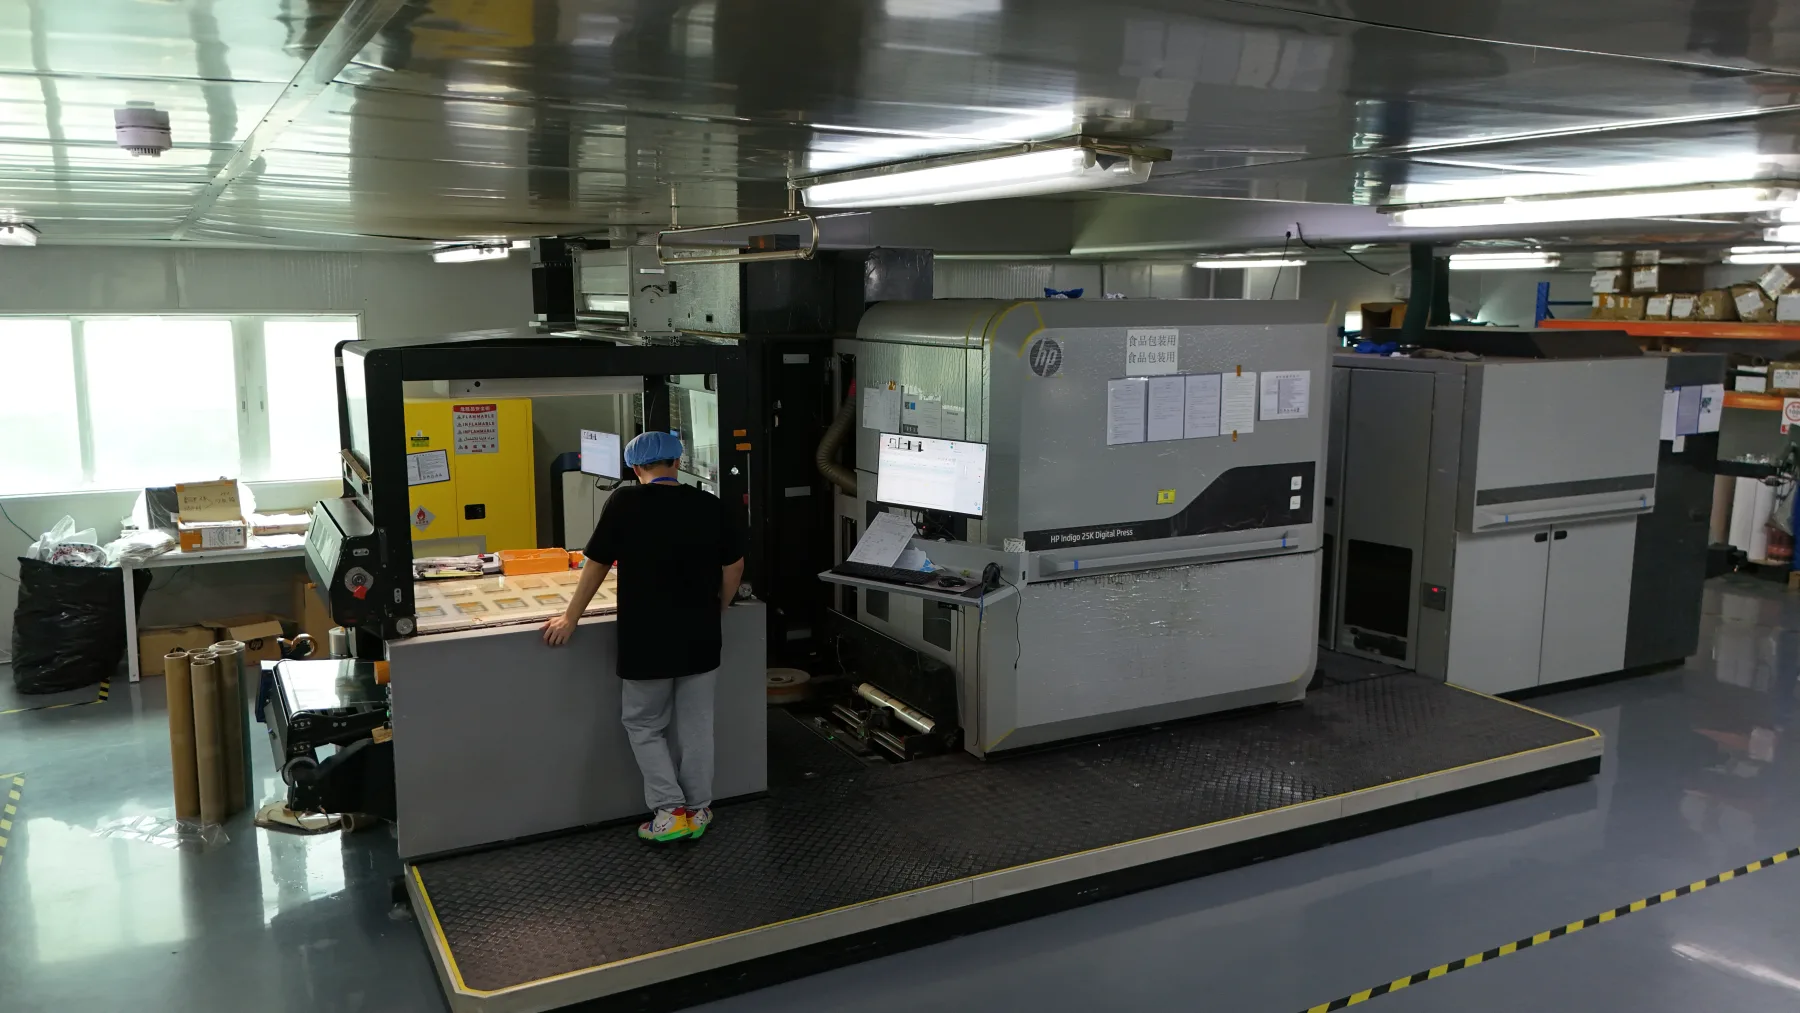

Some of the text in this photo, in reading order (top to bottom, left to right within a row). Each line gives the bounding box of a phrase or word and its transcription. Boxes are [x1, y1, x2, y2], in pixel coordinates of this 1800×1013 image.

[1128, 334, 1176, 347] 食品包装用
[1032, 338, 1061, 377] hp
[1128, 351, 1175, 364] 食品包装用
[1050, 535, 1060, 543] HP
[1061, 534, 1080, 542] Indigo
[1082, 532, 1094, 540] 25K
[1095, 530, 1115, 539] Digital
[250, 638, 263, 650] hp
